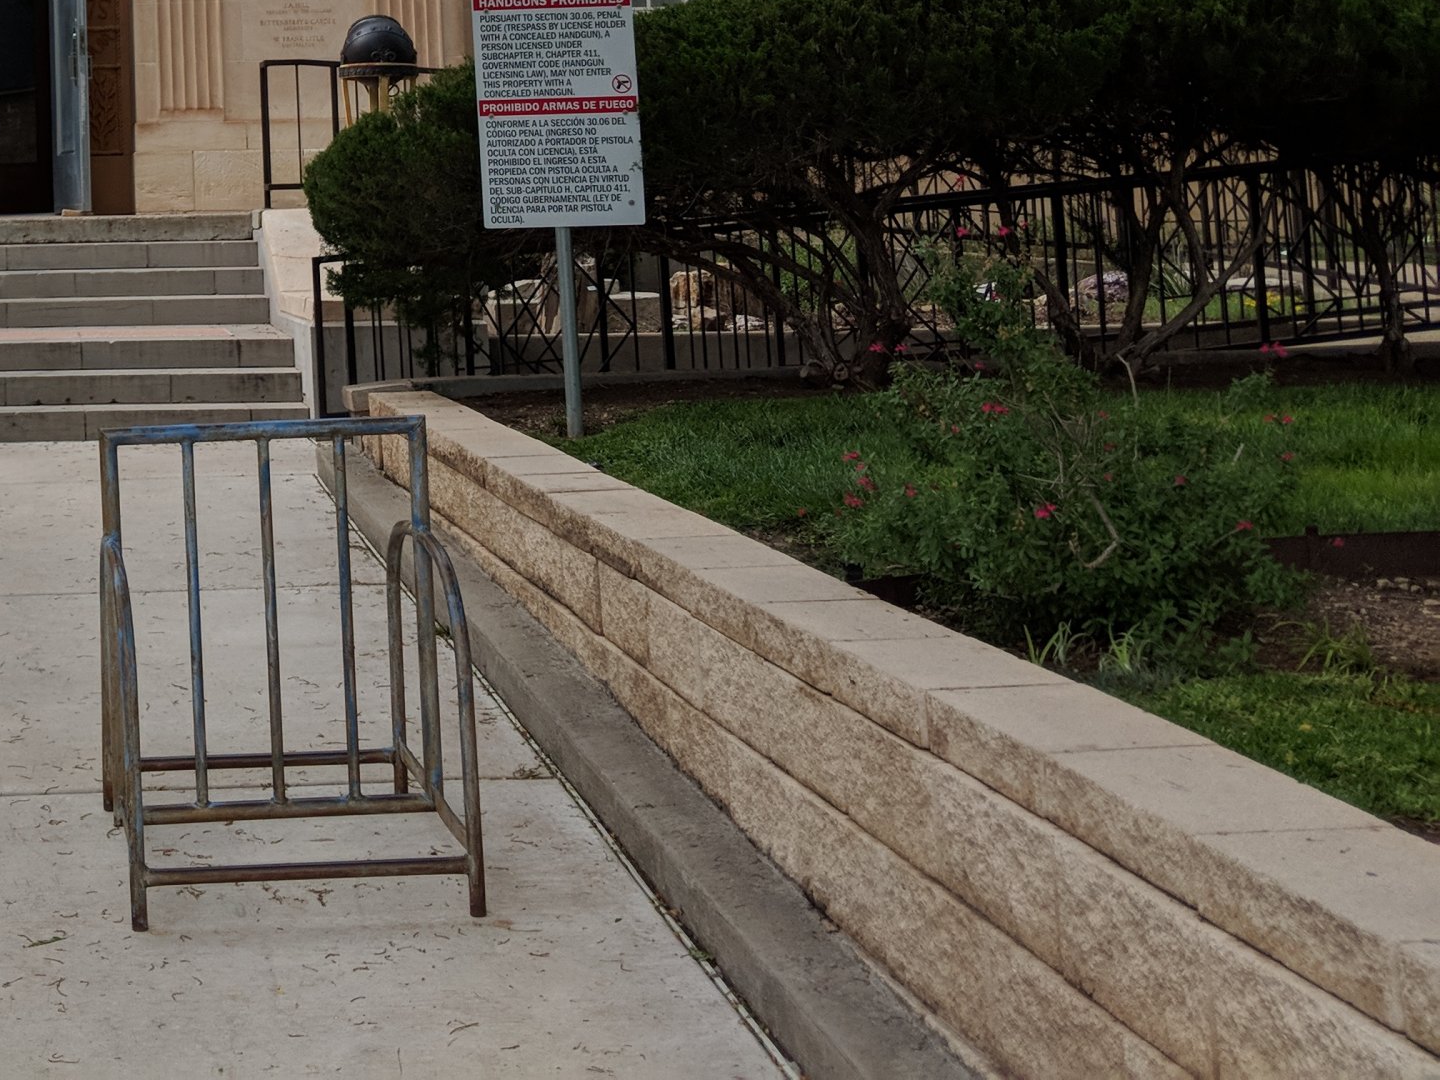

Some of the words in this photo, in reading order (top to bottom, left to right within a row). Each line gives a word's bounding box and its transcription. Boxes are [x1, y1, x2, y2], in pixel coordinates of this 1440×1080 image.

[480, 14, 521, 23] PURSUANT
[523, 14, 532, 22] TO
[535, 13, 568, 21] SECTION
[597, 11, 622, 19] PENAL
[480, 24, 501, 32] CODE
[549, 22, 558, 30] BY
[560, 21, 593, 29] LICENSE
[595, 20, 626, 28] HOLDER
[481, 43, 513, 51] PERSON
[515, 42, 553, 50] LICENSED
[555, 40, 582, 48] UNDER
[482, 61, 536, 70] GOVERNMENT
[538, 60, 560, 68] CODE
[502, 79, 543, 88] PROPERTY
[484, 89, 531, 98] CONCEALED
[482, 102, 539, 112] PROHIBIDO
[542, 101, 579, 111] ARMAS
[582, 100, 596, 109] DE
[599, 99, 634, 109] FUEGO
[486, 139, 535, 147] AUTORIZADO
[545, 138, 586, 146] PORTADOR
[601, 136, 633, 144] PISTOLA
[488, 158, 530, 166] PROHIBIDO
[544, 157, 578, 165] INGRESO
[588, 156, 606, 164] ESTA
[488, 168, 527, 176] PROPIEDA
[529, 167, 546, 175] CON
[548, 166, 579, 174] PISTOLA
[489, 177, 531, 186] PERSONAS
[552, 176, 587, 184] LICENCIA
[590, 175, 599, 183] EN
[601, 174, 629, 182] VIRTUD
[490, 206, 524, 214] LICENCIA
[526, 205, 546, 213] PARA
[581, 204, 612, 212] PISTOLA
